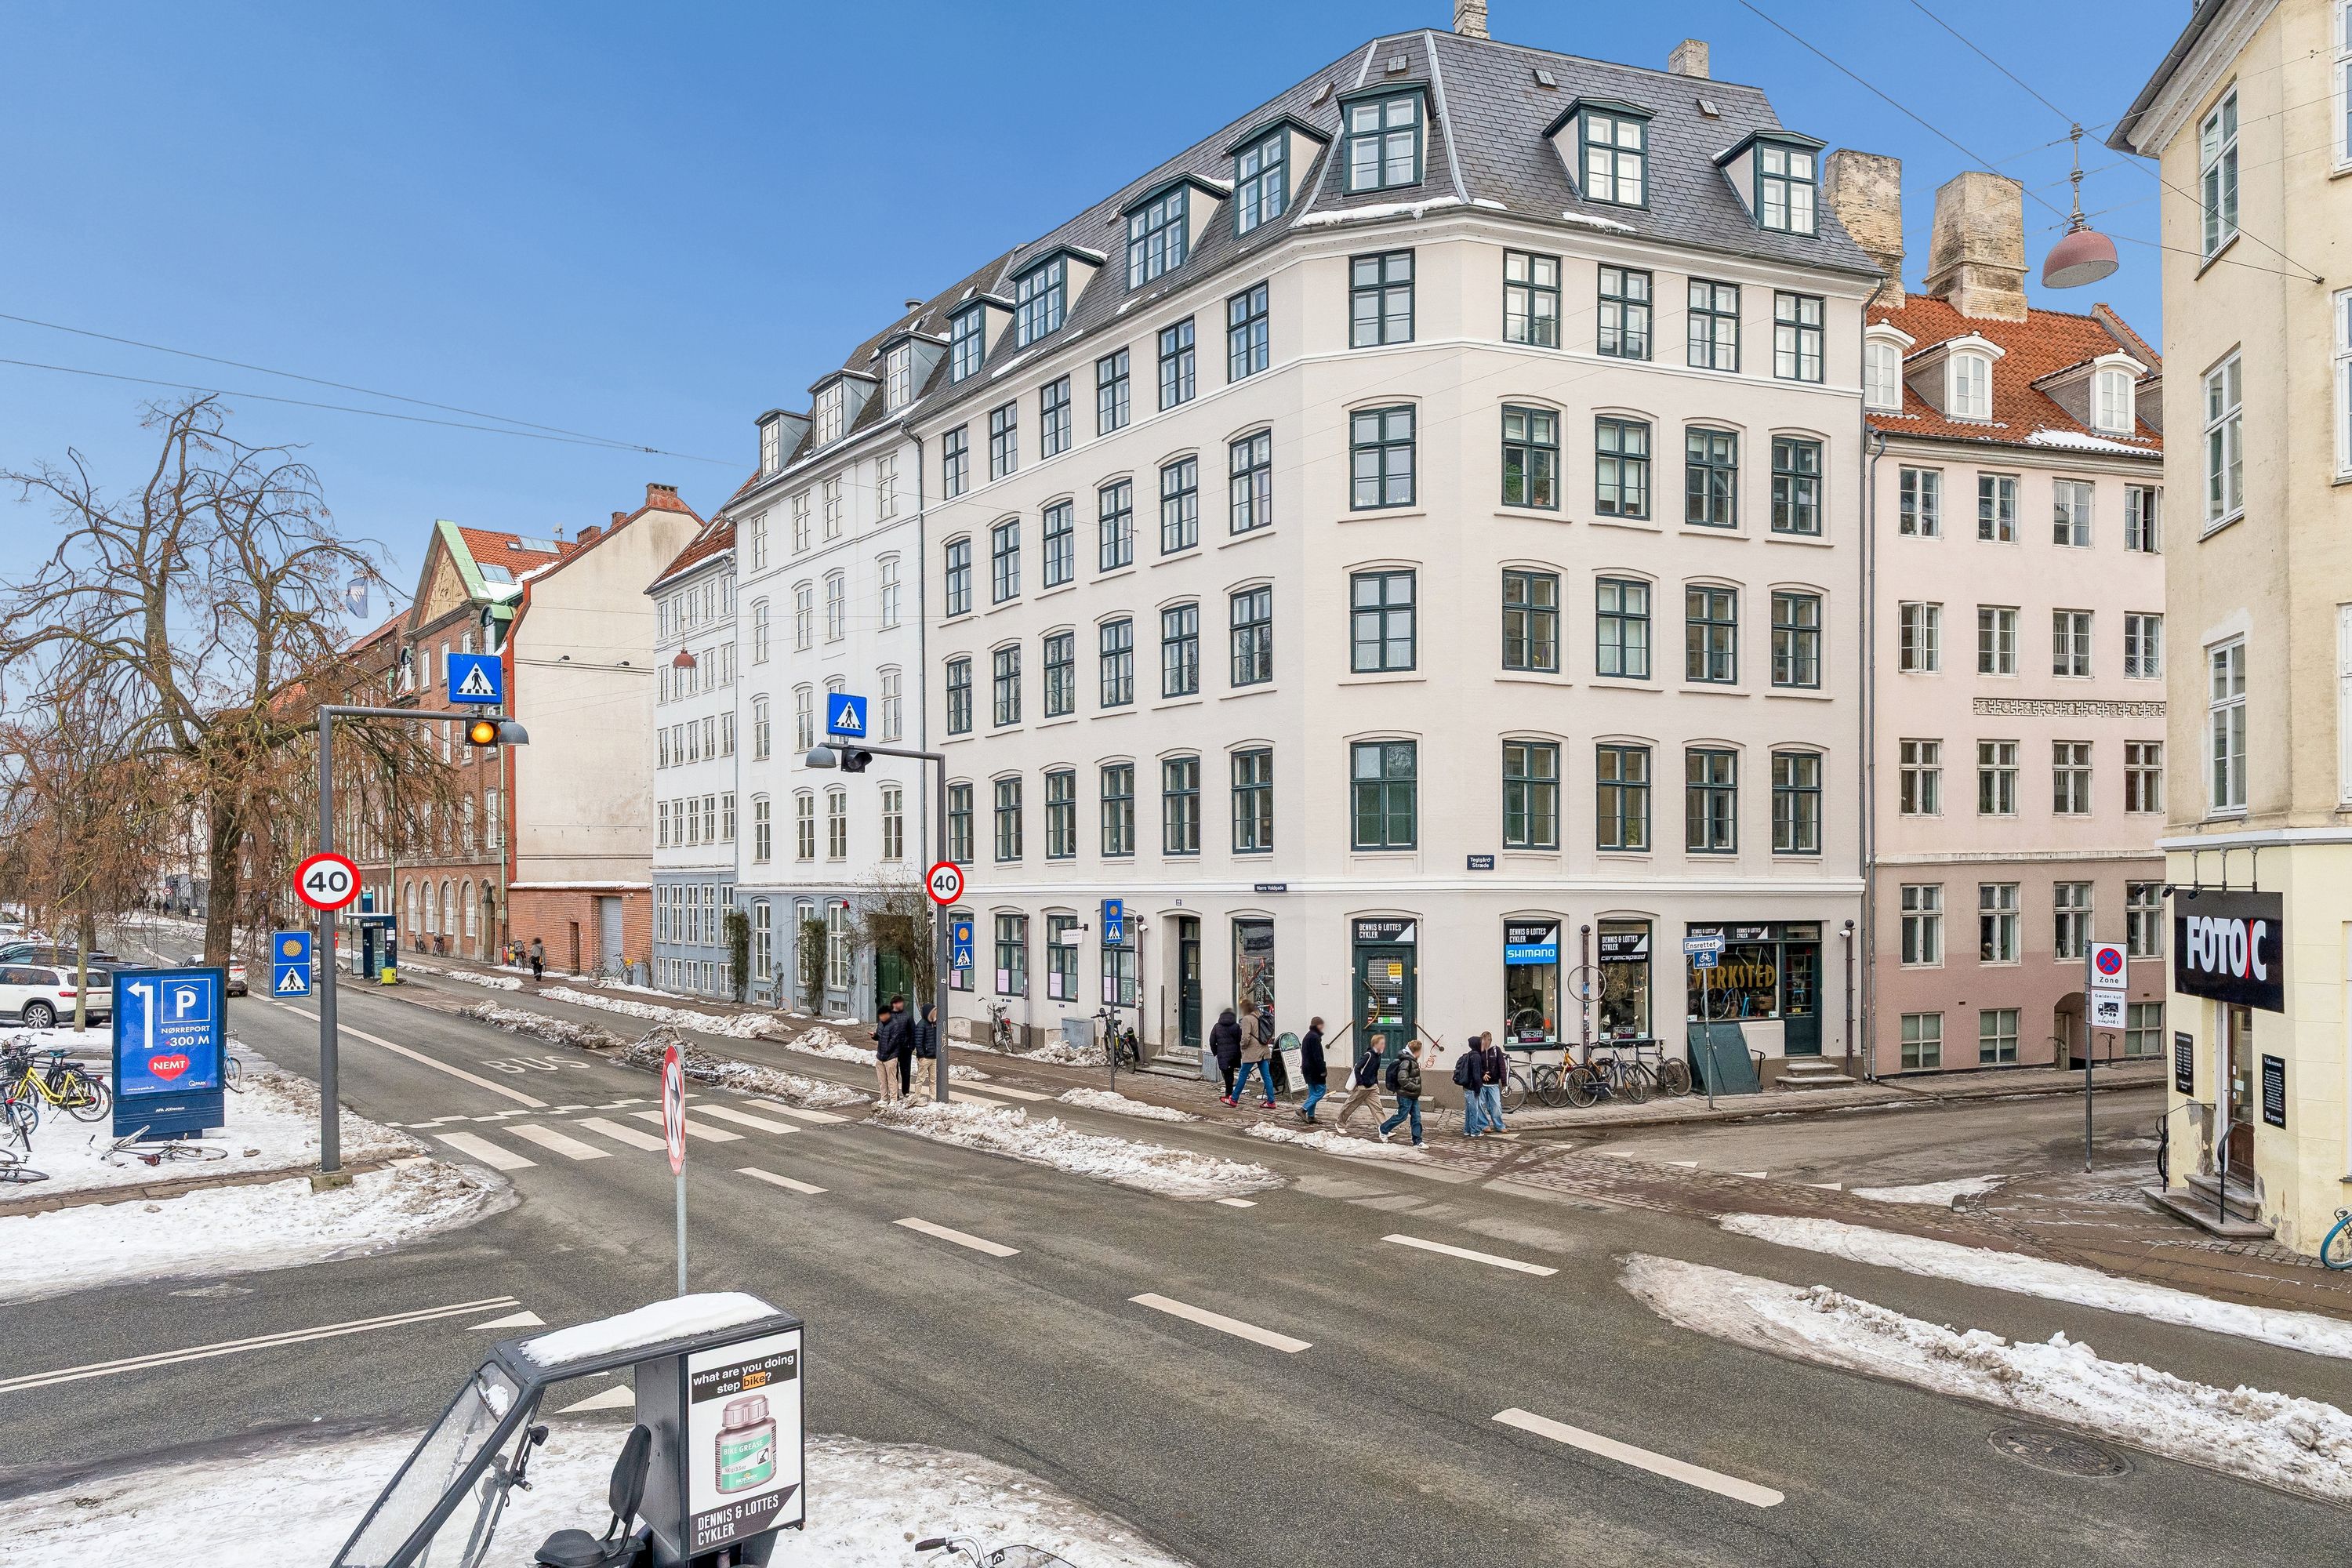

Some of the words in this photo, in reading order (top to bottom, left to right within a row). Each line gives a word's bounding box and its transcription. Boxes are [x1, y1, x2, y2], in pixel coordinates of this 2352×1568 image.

[307, 871, 348, 892] 40
[933, 875, 956, 891] 40
[1508, 949, 1555, 958] SHIMANO
[176, 990, 197, 1018] P
[162, 1025, 210, 1034] NØRREPORT
[170, 1036, 194, 1046] 300
[198, 1036, 210, 1044] M
[154, 1060, 185, 1070] NEMT
[479, 1055, 590, 1074] BUS
[693, 1371, 720, 1385] what
[722, 1367, 739, 1379] are
[742, 1362, 761, 1376] you
[764, 1355, 794, 1369] doing
[717, 1381, 740, 1393] step
[743, 1372, 771, 1387] bike?
[739, 1439, 763, 1453] GREASE
[698, 1508, 732, 1530] DENNIS
[735, 1505, 742, 1519] &
[745, 1494, 779, 1516] LOTTES
[698, 1523, 735, 1545] CYKLER
